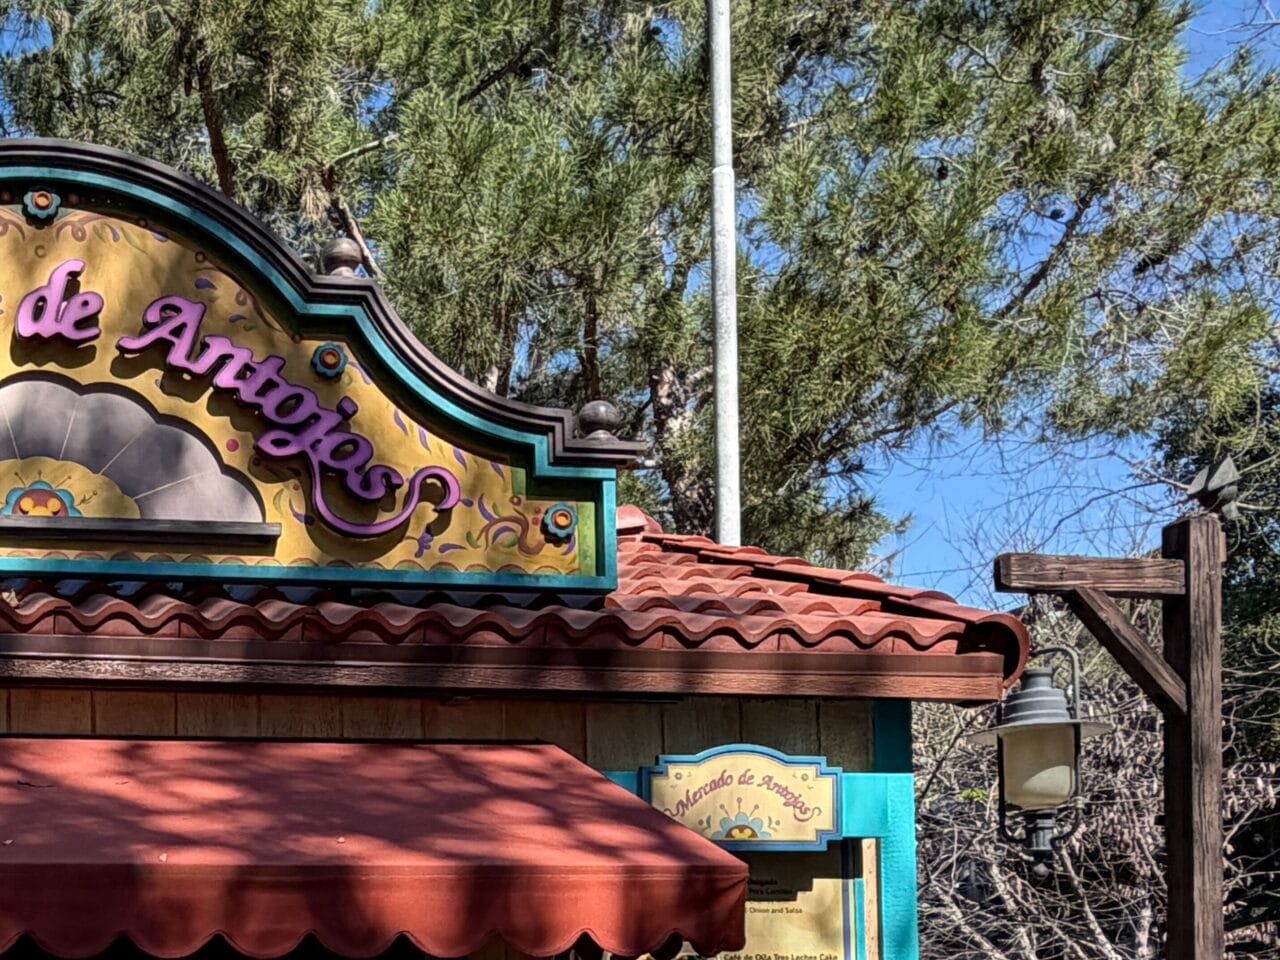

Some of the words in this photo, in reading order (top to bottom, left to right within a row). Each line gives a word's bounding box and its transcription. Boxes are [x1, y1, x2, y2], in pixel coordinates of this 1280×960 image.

[18, 258, 103, 344] de
[119, 294, 462, 537] Antojos
[664, 769, 733, 817] Mercado
[738, 768, 754, 785] de
[757, 775, 822, 822] Antojos
